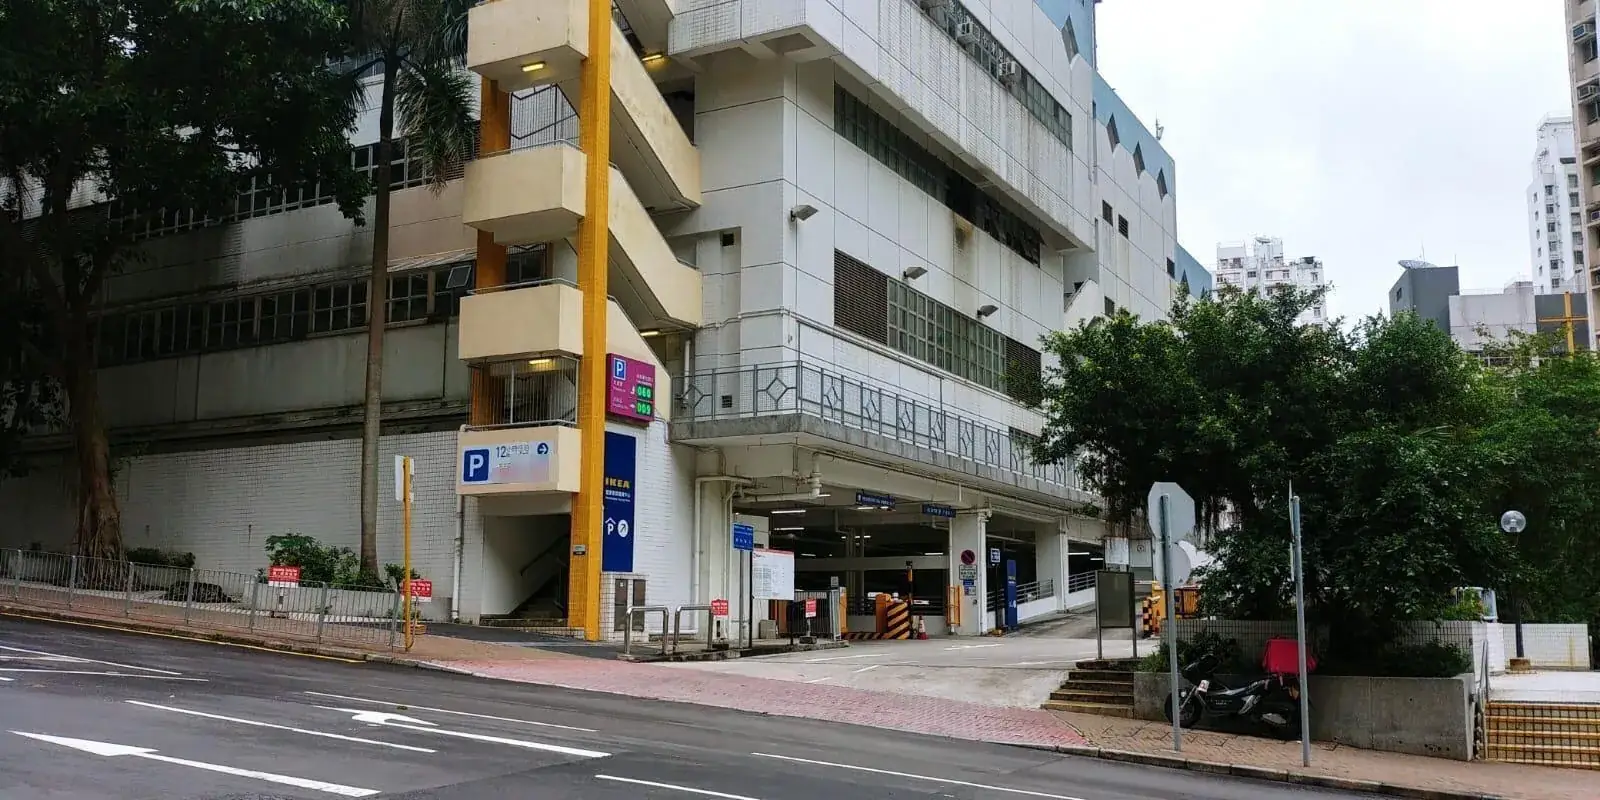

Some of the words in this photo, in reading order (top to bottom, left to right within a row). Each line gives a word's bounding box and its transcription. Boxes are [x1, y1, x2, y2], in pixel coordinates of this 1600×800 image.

[616, 361, 624, 377] P
[469, 454, 484, 478] P
[605, 477, 630, 489] IKEA
